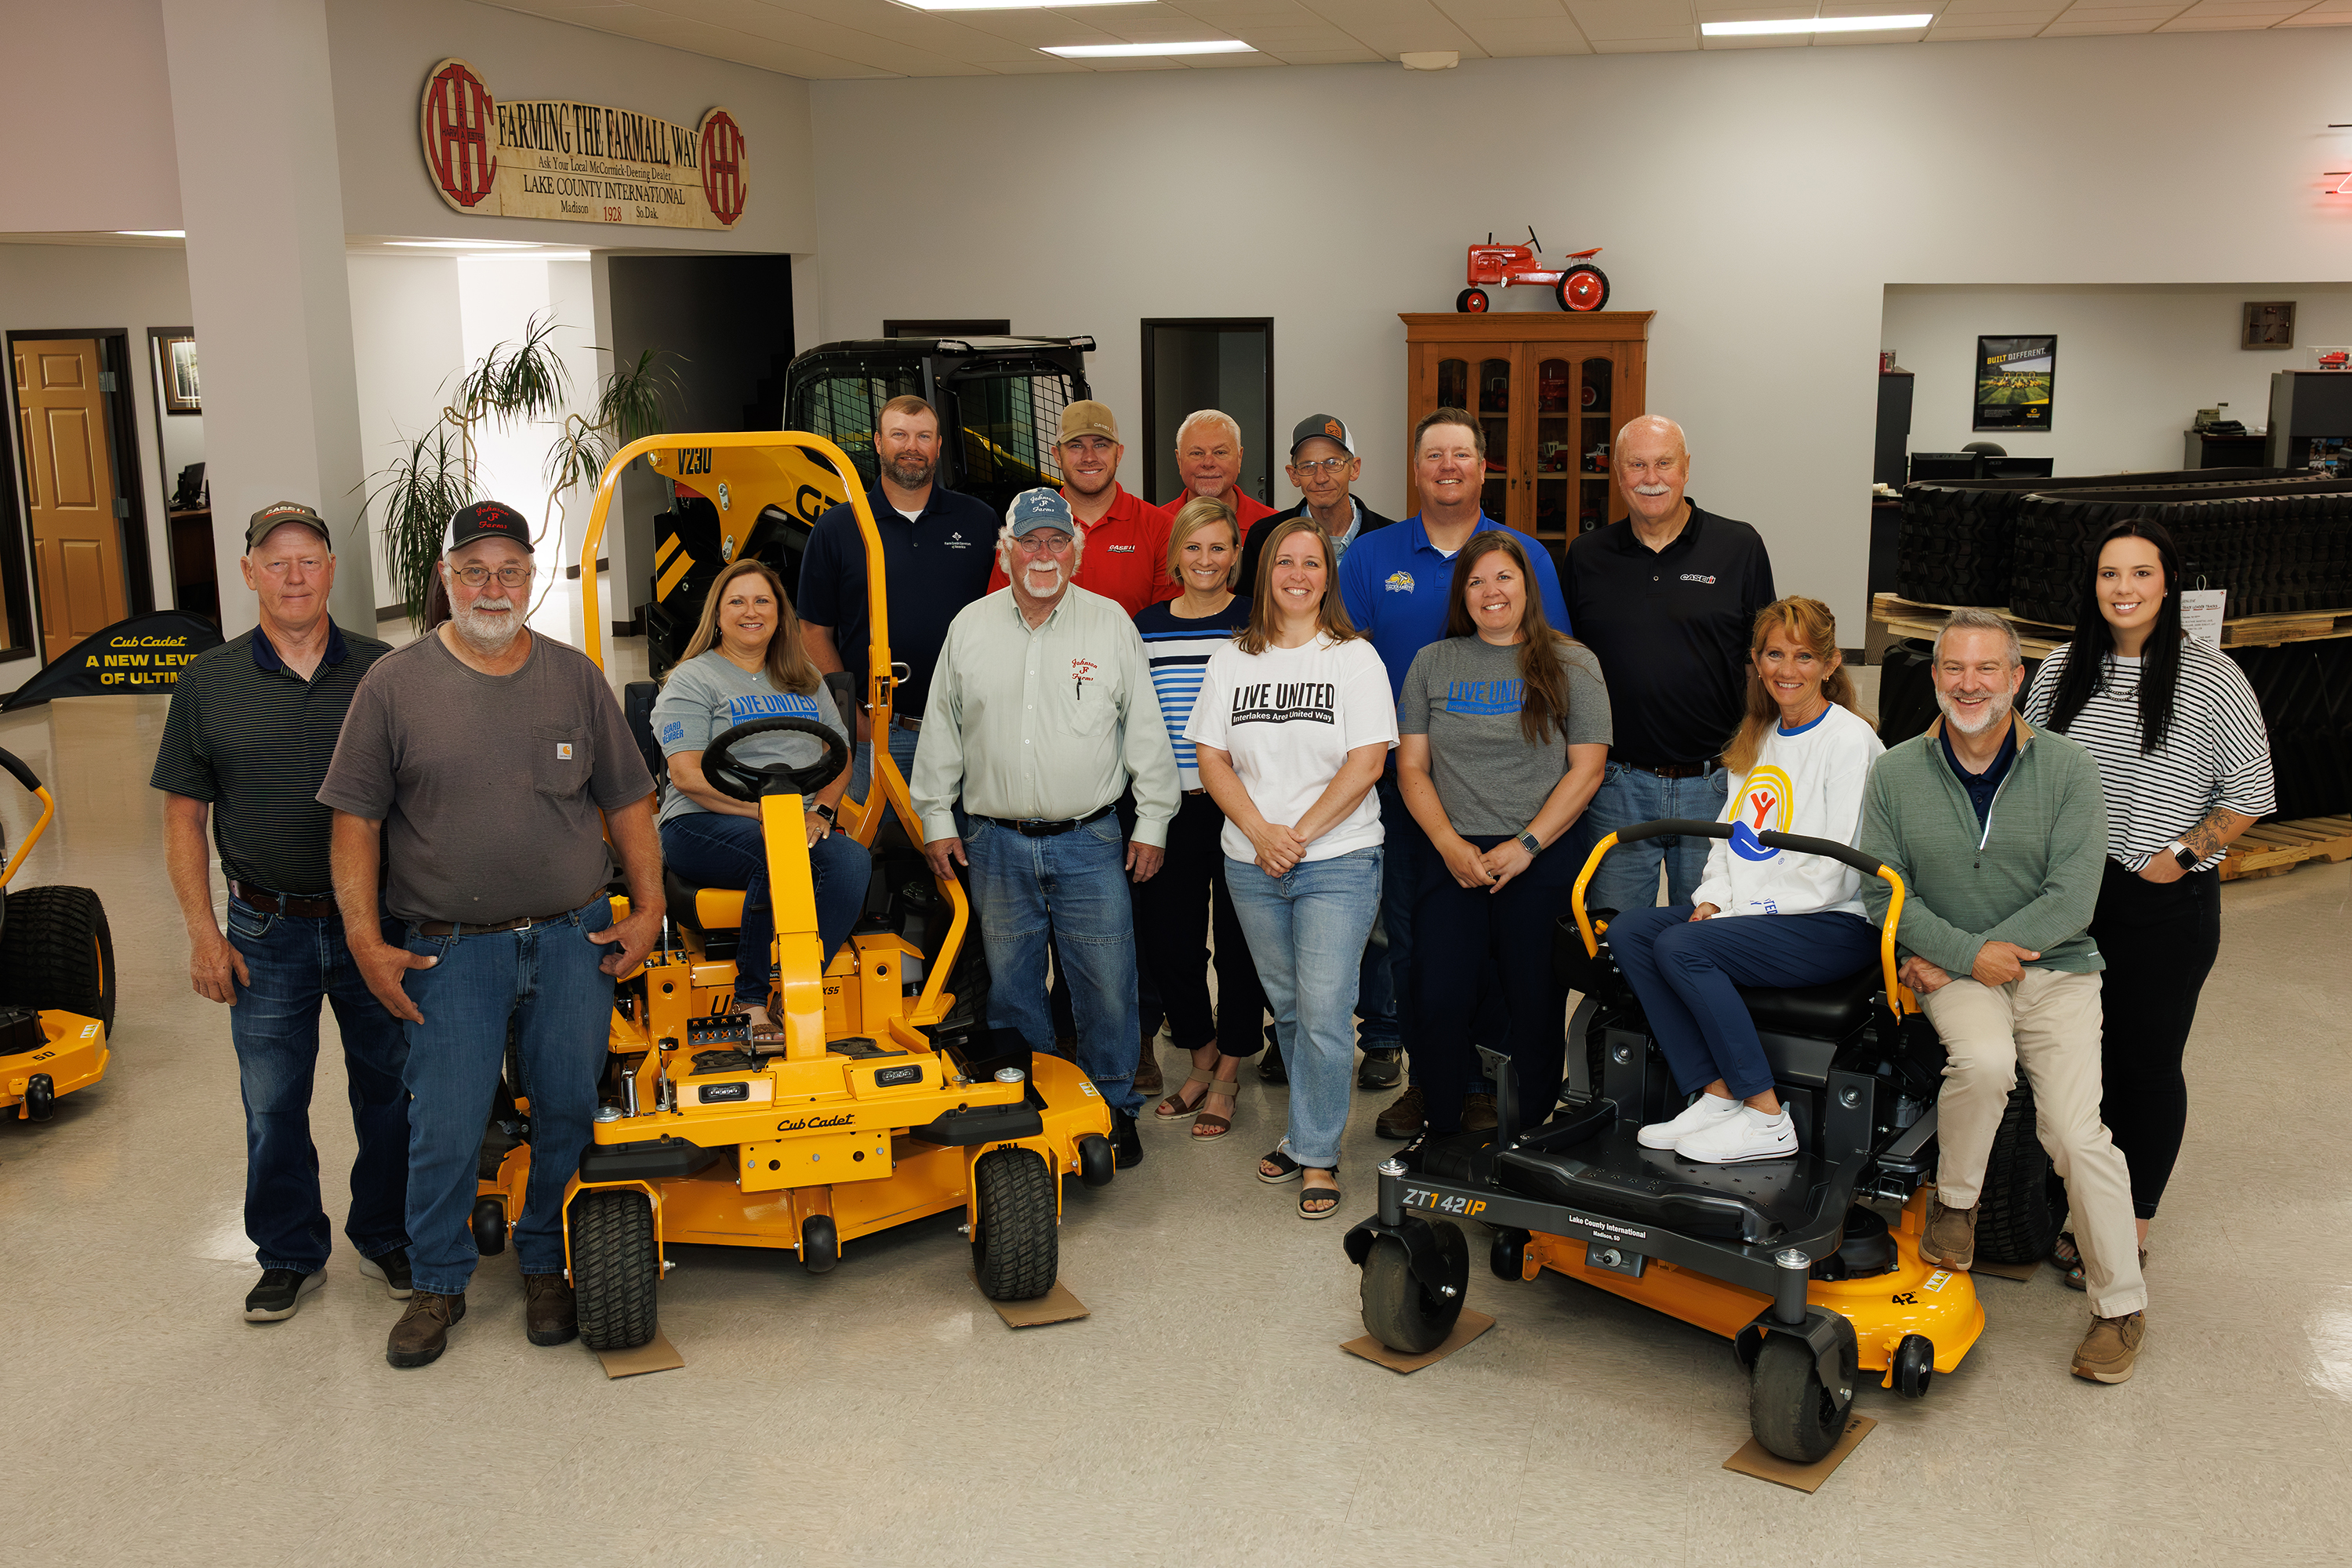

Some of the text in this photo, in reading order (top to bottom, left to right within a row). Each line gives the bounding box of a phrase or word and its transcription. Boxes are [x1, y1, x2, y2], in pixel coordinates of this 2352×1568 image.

[496, 103, 699, 169] FARMING THE FARMALL WAY
[539, 156, 671, 183] Ask Your Local McCormick-Deering Dealer
[523, 174, 686, 205] LAKE COUNTY INTERNATIONAL
[561, 200, 589, 214] Madison
[603, 206, 622, 222] 1928
[1987, 347, 2046, 365] BUILT DIFFERENT.
[1030, 494, 1055, 503] Johnson
[476, 505, 510, 517] Johnson
[478, 521, 507, 529] Farms
[1680, 574, 1707, 583] CASE
[110, 636, 188, 648] Cub Cadet
[85, 655, 100, 667] A
[104, 654, 149, 666] NEW
[1071, 658, 1098, 669] Johnson
[100, 673, 125, 684] OF
[1232, 682, 1334, 712] LIVE UNITED
[1448, 681, 1486, 702] LIVE
[728, 693, 818, 717] LIVE UNITED
[1233, 712, 1271, 723] Interlakes
[1289, 710, 1313, 719] United
[1315, 711, 1332, 722] Way
[32, 1051, 56, 1061] 50
[777, 1113, 855, 1131] Cub Cadet
[1403, 1189, 1486, 1215] ZT1 42IP
[1569, 1214, 1646, 1239] Lake County International
[1592, 1230, 1613, 1240] Madison,
